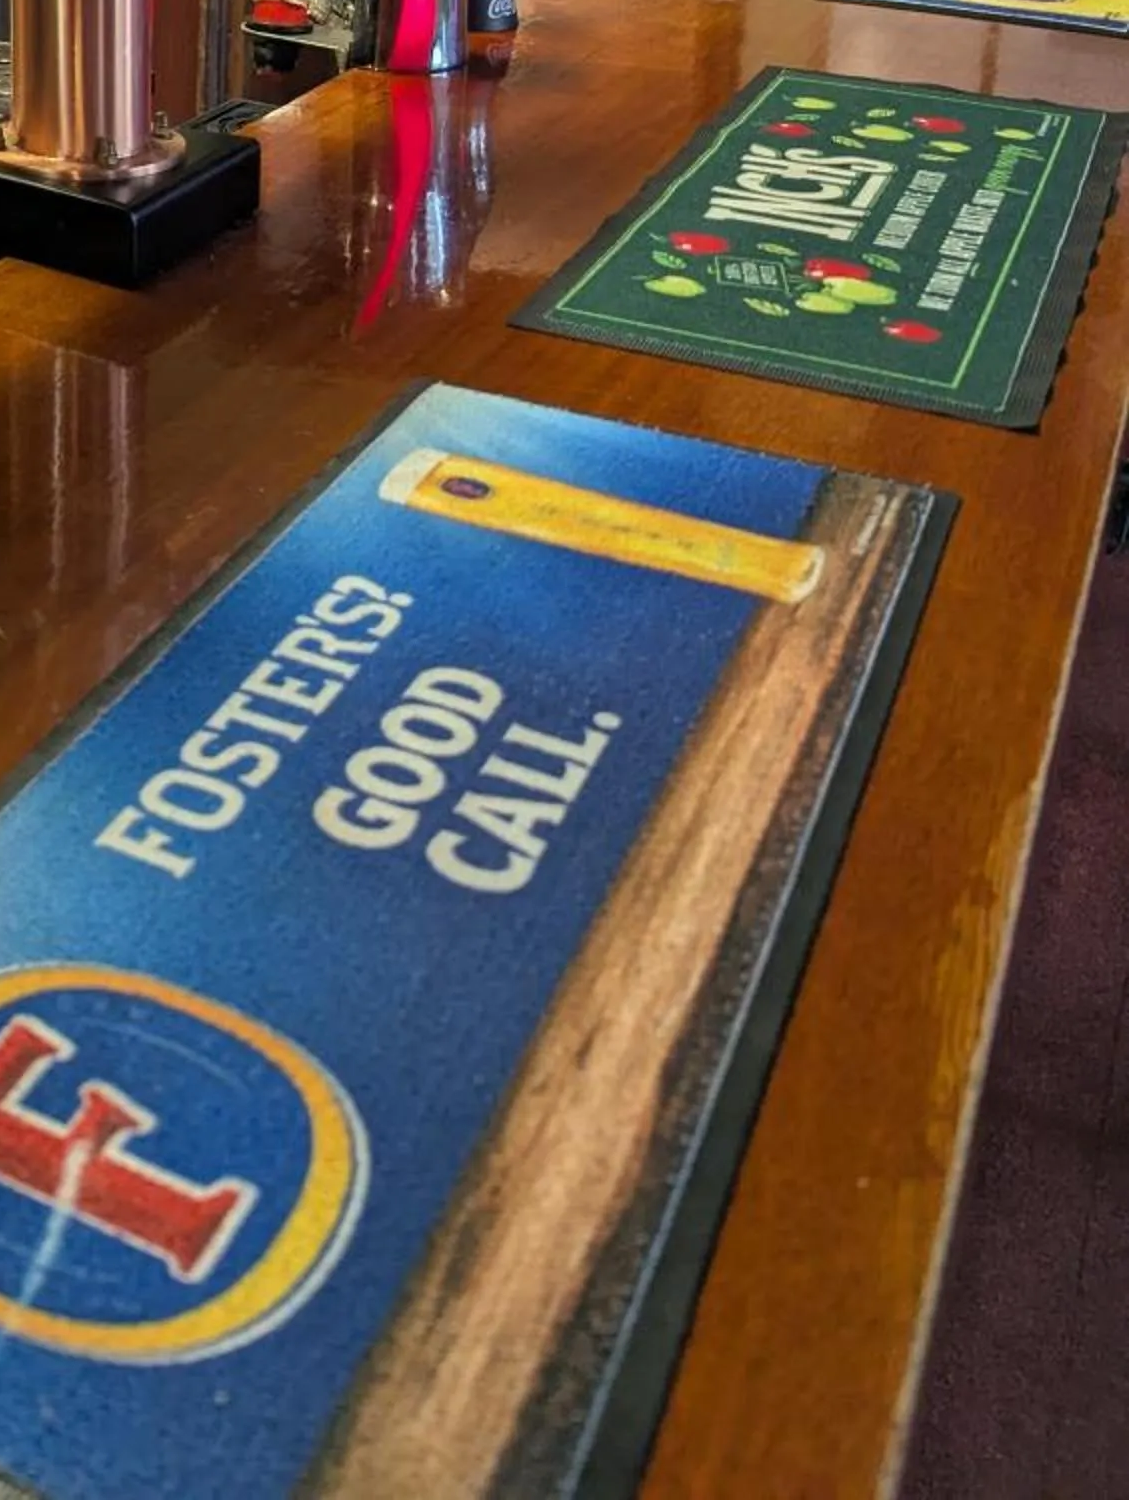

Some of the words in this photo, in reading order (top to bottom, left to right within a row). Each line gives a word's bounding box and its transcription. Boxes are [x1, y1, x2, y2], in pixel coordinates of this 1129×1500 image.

[96, 574, 415, 880] FOSTER'S?
[312, 666, 505, 850] GOOD
[425, 710, 622, 894] CALL.
